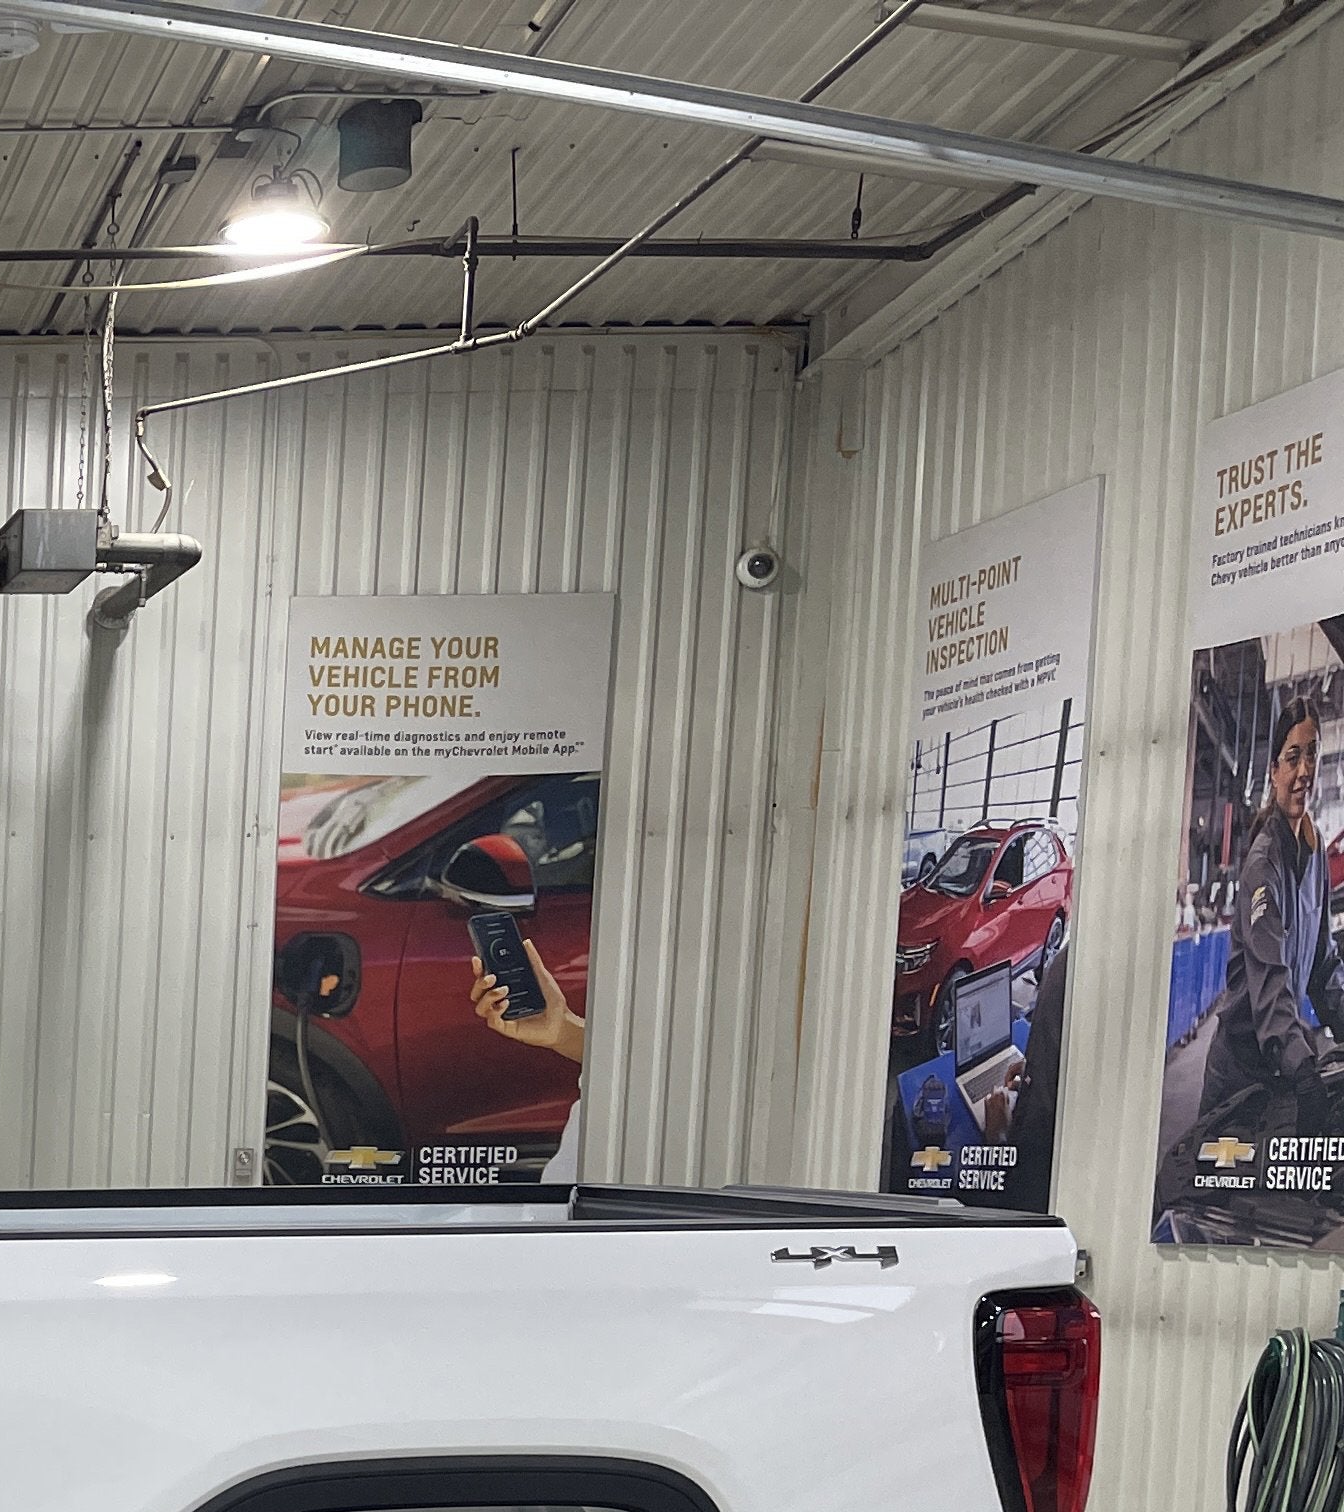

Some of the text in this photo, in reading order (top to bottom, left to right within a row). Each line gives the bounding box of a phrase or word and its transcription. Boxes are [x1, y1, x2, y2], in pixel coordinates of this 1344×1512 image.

[1217, 432, 1323, 499] TRUST THE
[1215, 480, 1308, 536] EXPERTS.
[1212, 549, 1245, 569] Factory
[1247, 536, 1277, 558] trained
[1280, 518, 1332, 547] technicians
[1211, 571, 1237, 587] Chevy
[1238, 560, 1268, 579] vehicle
[1270, 551, 1298, 569] better
[1301, 544, 1322, 560] than
[930, 555, 1022, 610] MULTI-POINT
[928, 601, 986, 642] VEHICLE
[311, 636, 500, 659] MANAGE YOUR
[926, 626, 1009, 675] INSPECTION
[309, 665, 500, 688] VEHICLE FROM
[307, 694, 481, 718] YOUR PHONE.
[305, 729, 566, 744] View real-time diagnostics and enjoy remote
[340, 744, 391, 756] available
[395, 746, 409, 756] on
[412, 745, 431, 756] the
[434, 745, 509, 759] myChevrolet
[512, 743, 549, 756] Mobile
[419, 1146, 517, 1164] CERTIFIED
[961, 1146, 1017, 1166] CERTIFIED
[322, 1174, 404, 1184] CHEVROLET
[418, 1167, 500, 1184] SERVICE
[908, 1178, 952, 1189] CHEVROLET
[959, 1169, 1006, 1190] SERVICE
[1194, 1175, 1256, 1189] CHEVROLET
[1266, 1166, 1333, 1190] SERVICE
